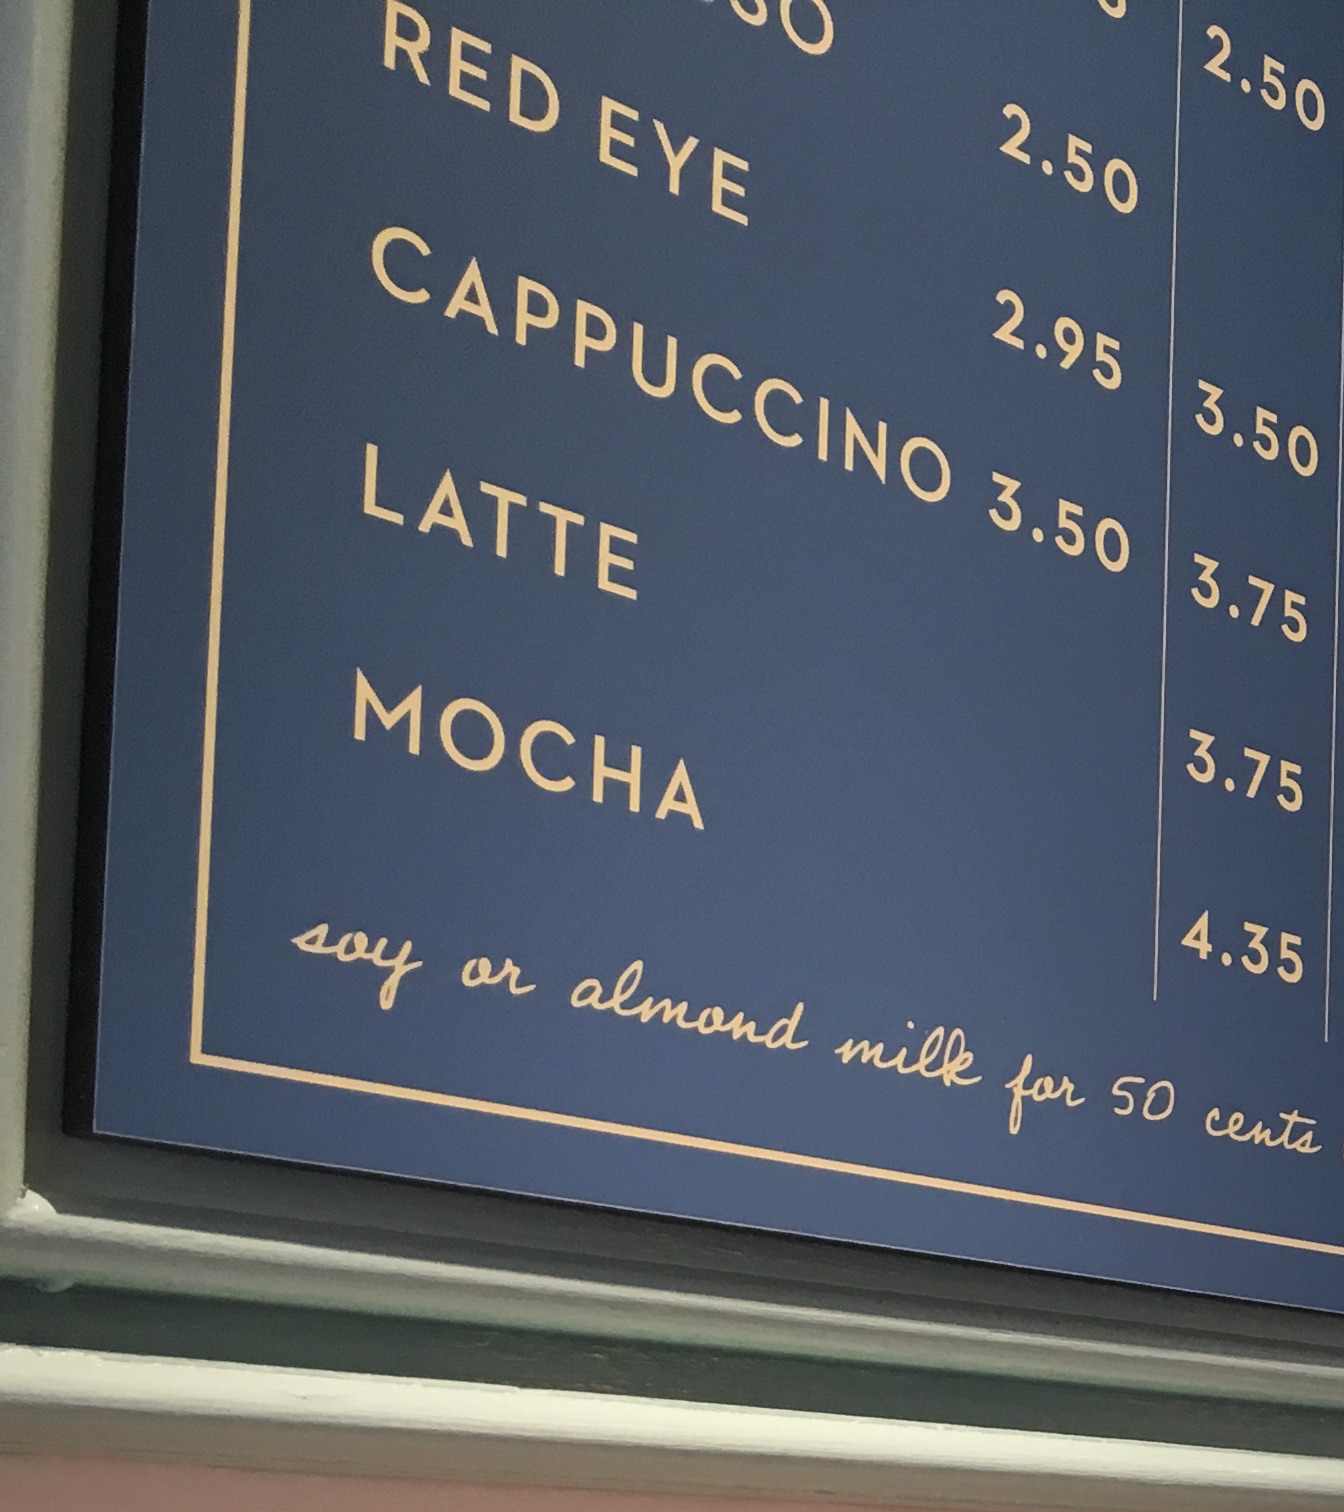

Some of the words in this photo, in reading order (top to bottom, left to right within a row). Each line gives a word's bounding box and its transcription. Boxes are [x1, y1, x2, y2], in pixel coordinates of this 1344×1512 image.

[383, 0, 561, 133] RED
[600, 96, 750, 226] EYE
[1205, 25, 1325, 131] 2.50
[999, 103, 1138, 214] 2.50
[992, 289, 1123, 390] 2.95
[371, 226, 951, 502] CAPPUCCINO
[989, 472, 1129, 572] 3.50
[1195, 379, 1318, 477] 3.50
[363, 443, 638, 600] LATTE
[1191, 552, 1307, 642] 3.75
[354, 668, 704, 830] MOCHA
[1186, 729, 1303, 813] 3.75
[1181, 909, 1303, 984] 4.35
[291, 923, 423, 1010] soy
[462, 957, 536, 994] or
[571, 960, 808, 1052] almond
[835, 1021, 982, 1087] milk
[1005, 1054, 1086, 1135] for
[1112, 1077, 1175, 1120] 50
[1205, 1106, 1322, 1155] cents
